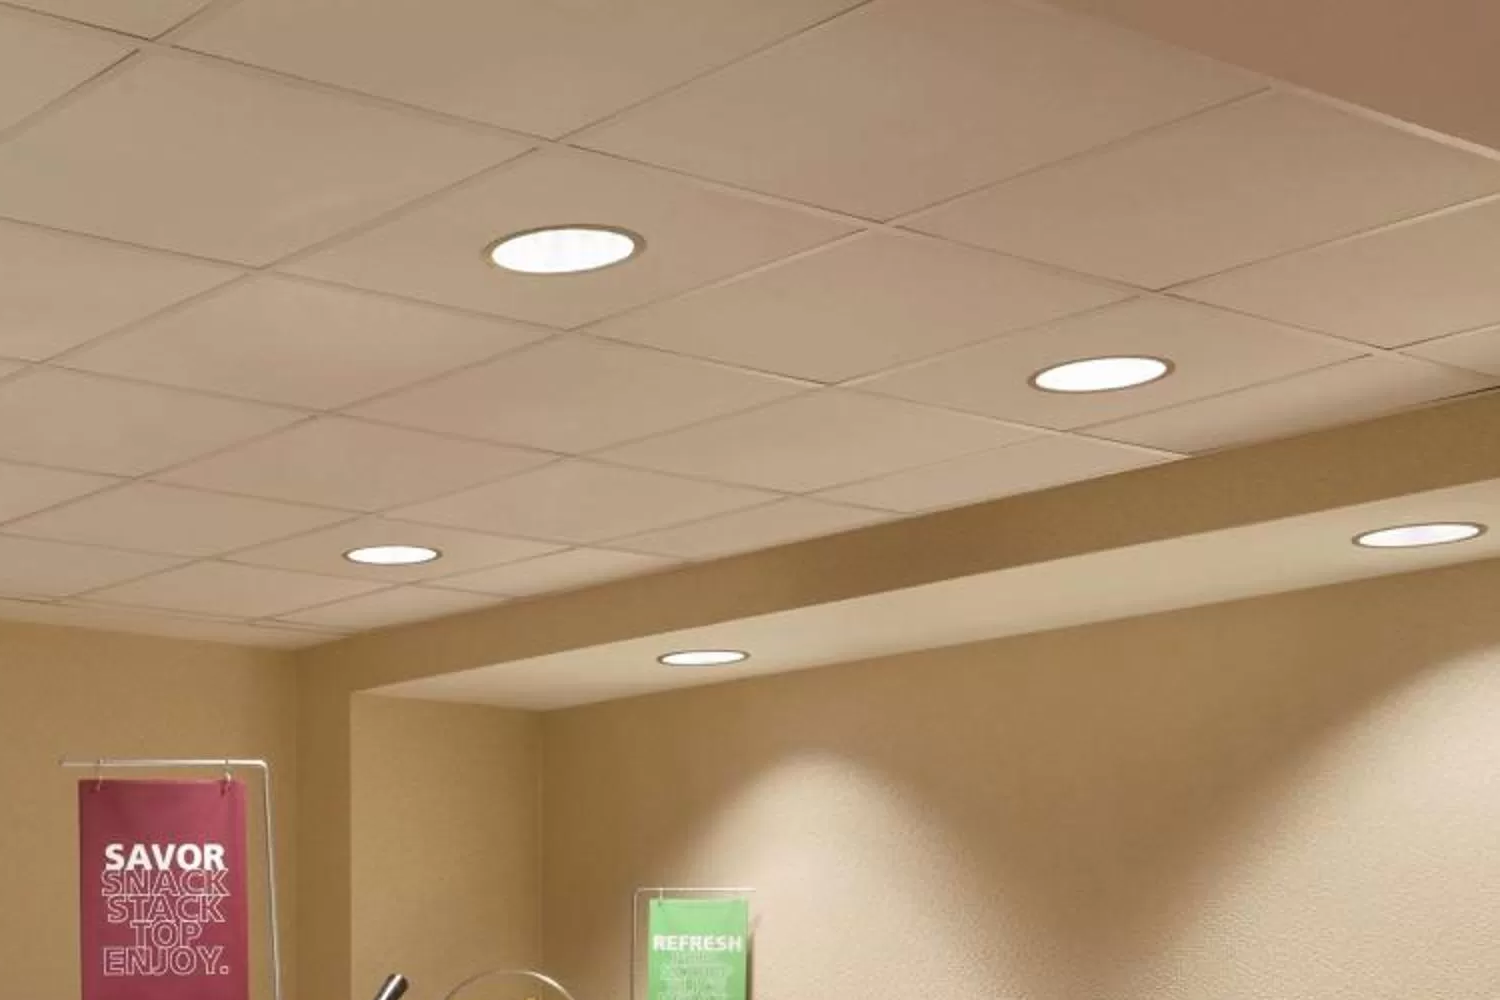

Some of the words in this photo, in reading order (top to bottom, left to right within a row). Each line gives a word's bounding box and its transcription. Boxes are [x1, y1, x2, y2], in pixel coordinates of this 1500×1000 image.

[104, 843, 226, 871] SAVOR
[101, 868, 231, 897] SNACK
[106, 895, 226, 923] STACK
[129, 920, 203, 949] TOP
[652, 934, 742, 952] REFRESH
[102, 946, 231, 976] ENJOY.
